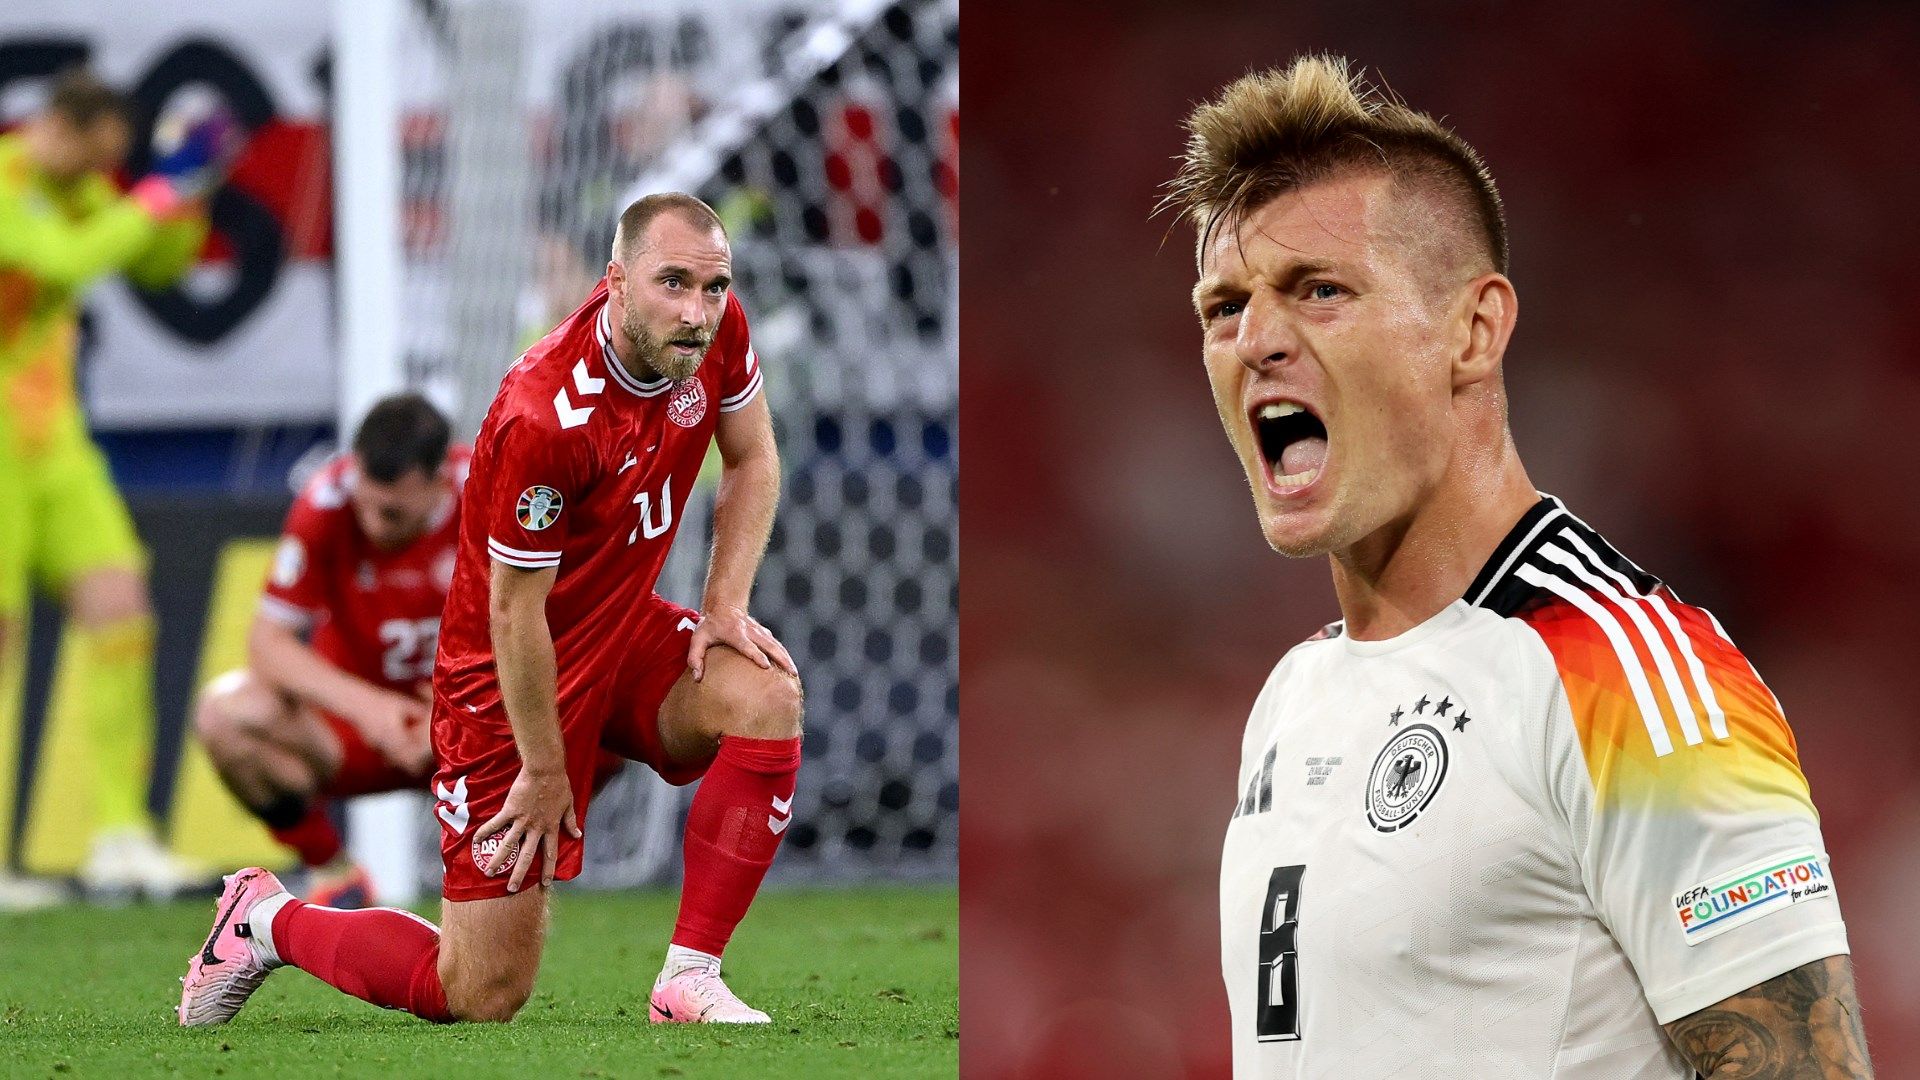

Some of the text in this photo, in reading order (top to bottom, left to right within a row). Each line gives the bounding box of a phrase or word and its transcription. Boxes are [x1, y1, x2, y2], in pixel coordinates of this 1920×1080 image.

[673, 388, 701, 414] DBU
[627, 473, 672, 546] 10
[1391, 737, 1435, 759] DEUTSCHER
[1375, 789, 1424, 818] FUSSBALL-BUND
[480, 838, 503, 855] DB
[1676, 885, 1709, 908] UEFA
[1791, 888, 1802, 902] for
[1257, 865, 1306, 1042] 8
